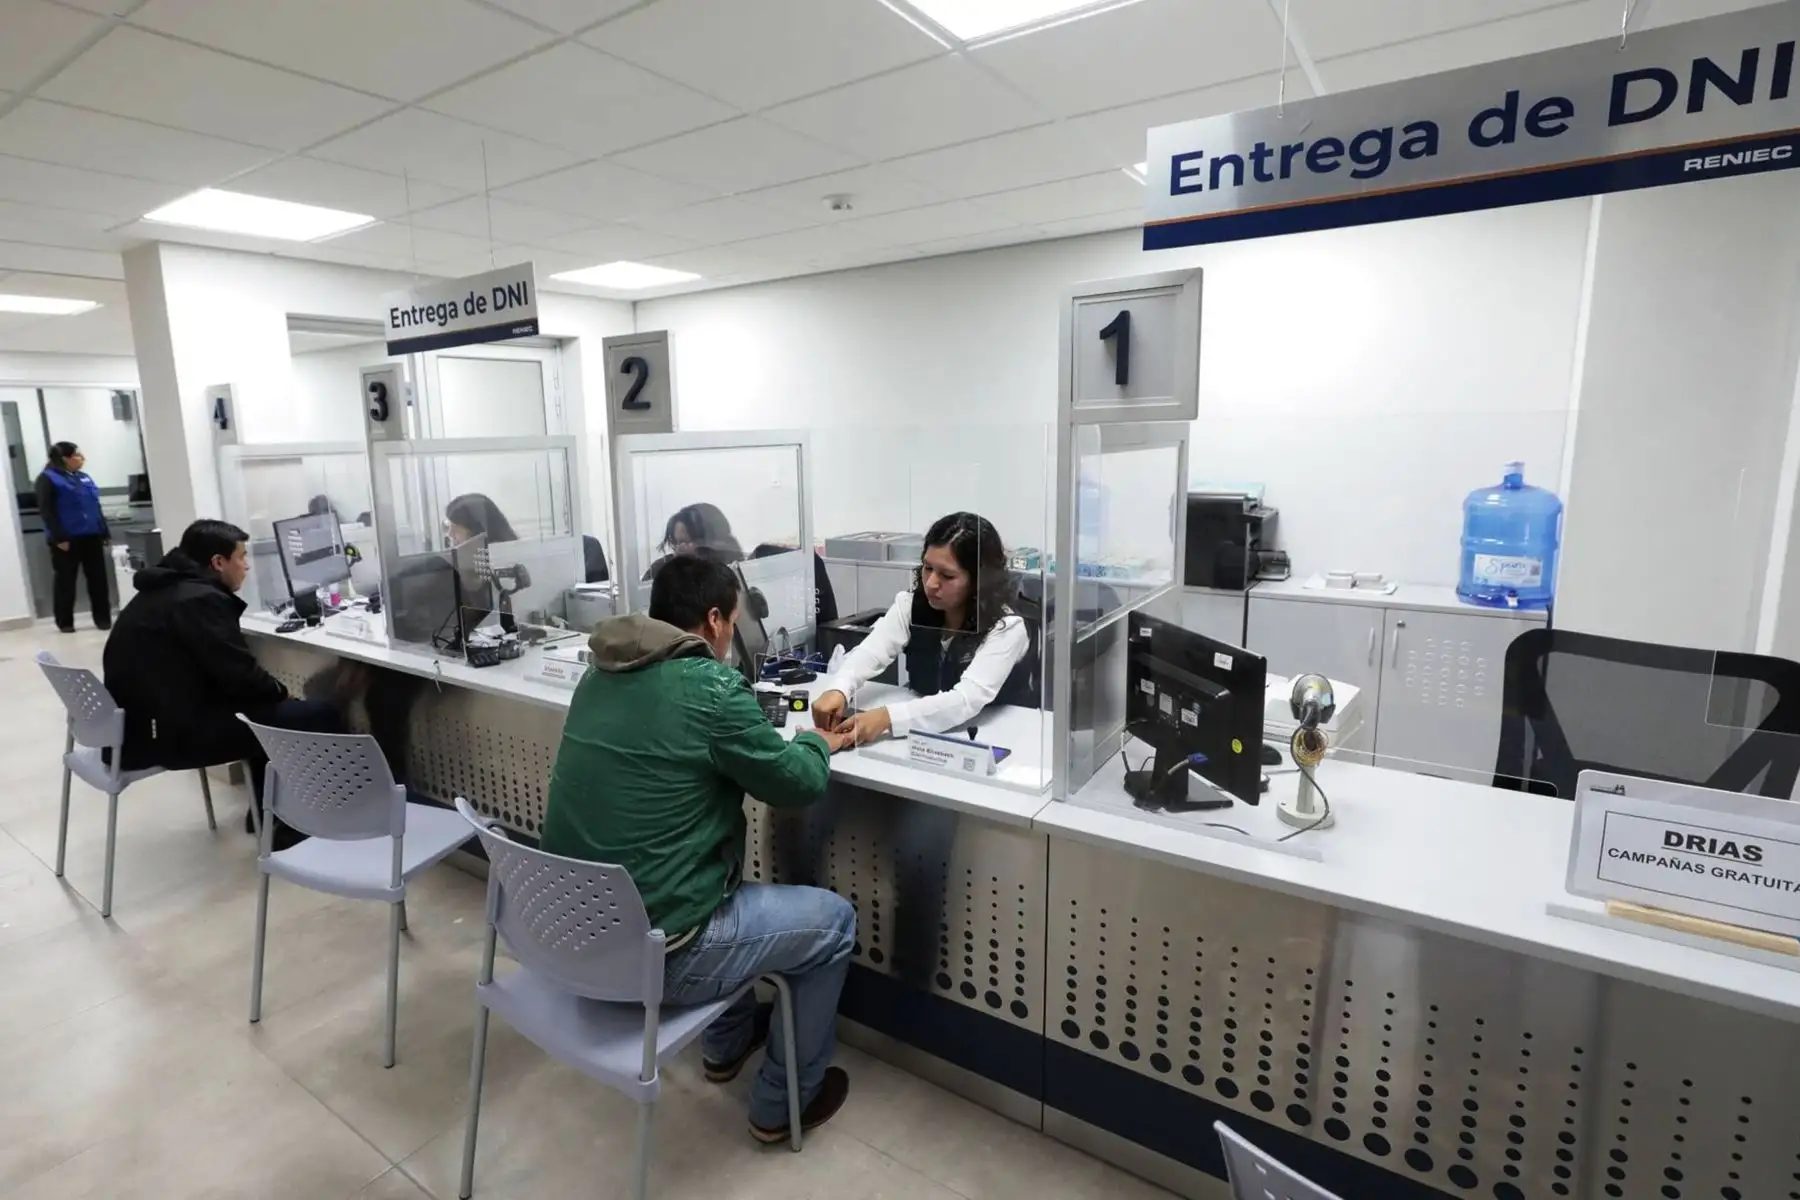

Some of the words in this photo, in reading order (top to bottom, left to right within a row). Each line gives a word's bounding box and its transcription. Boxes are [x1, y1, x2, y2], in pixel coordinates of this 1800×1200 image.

[1170, 120, 1439, 196] Entrega
[1468, 90, 1575, 147] de
[1608, 41, 1796, 127] DNI
[1684, 145, 1793, 171] RENIEC
[390, 300, 458, 328] Entrega
[463, 291, 487, 316] de
[492, 281, 529, 311] DNI
[1099, 310, 1130, 385] 1
[368, 381, 389, 422] 3
[620, 356, 651, 410] 2
[213, 397, 228, 430] 4
[1608, 848, 1705, 874] CAMPAÑAS
[1664, 830, 1763, 862] DRIAS
